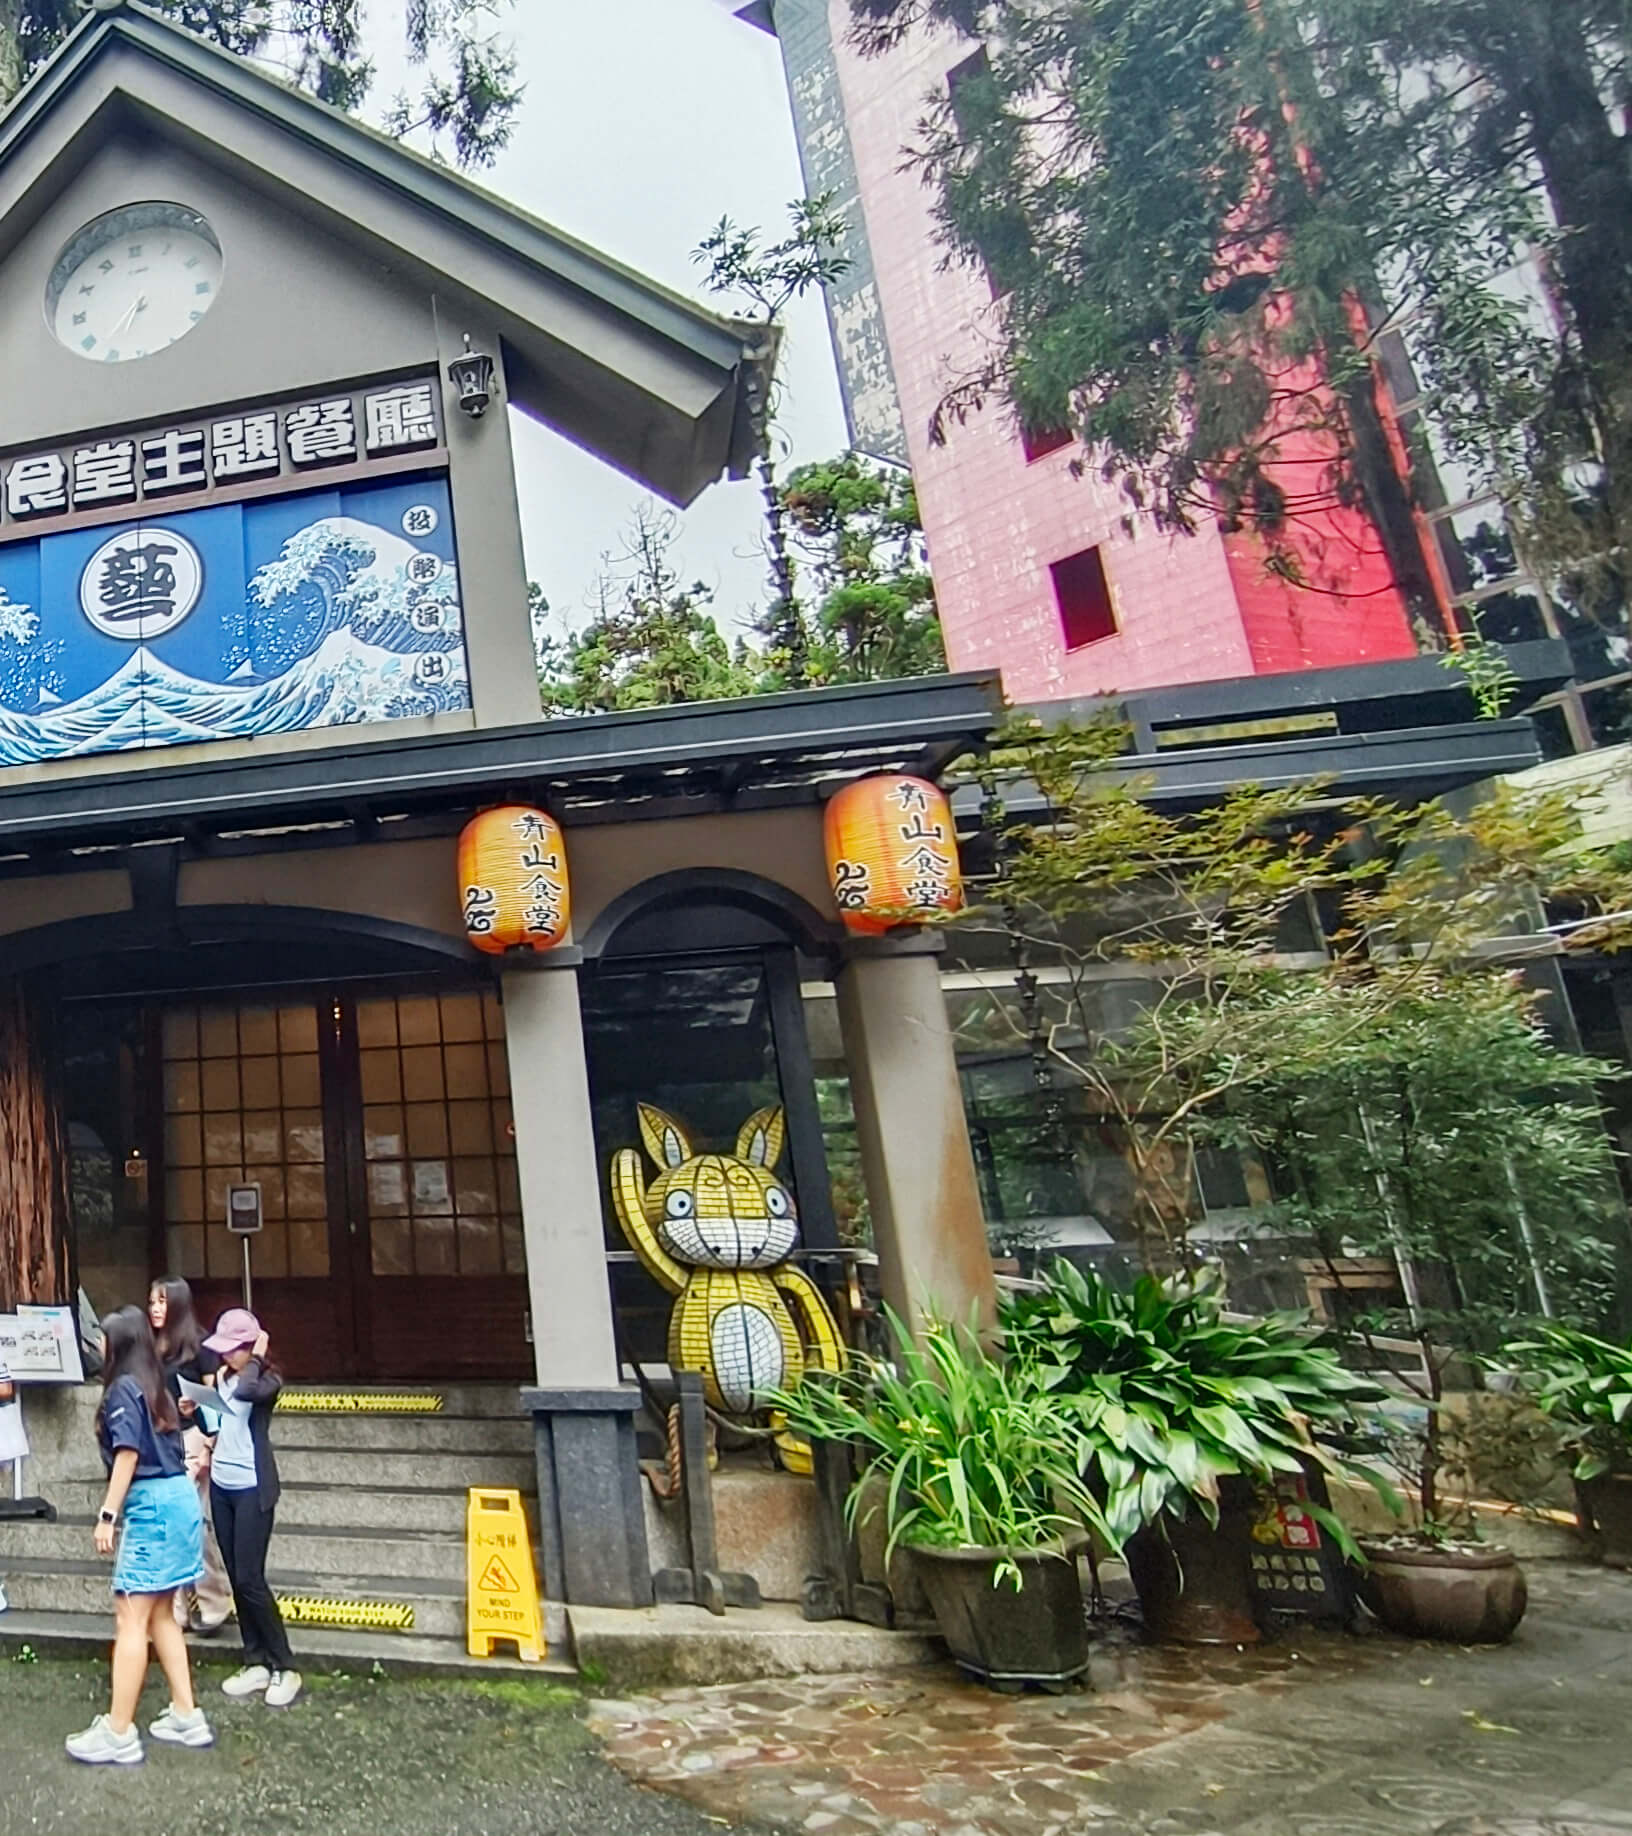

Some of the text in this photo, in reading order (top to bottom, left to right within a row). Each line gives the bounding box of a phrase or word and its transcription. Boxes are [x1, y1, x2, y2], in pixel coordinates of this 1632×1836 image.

[489, 1598, 511, 1608] MIND
[477, 1608, 525, 1621] YOUR STEP
